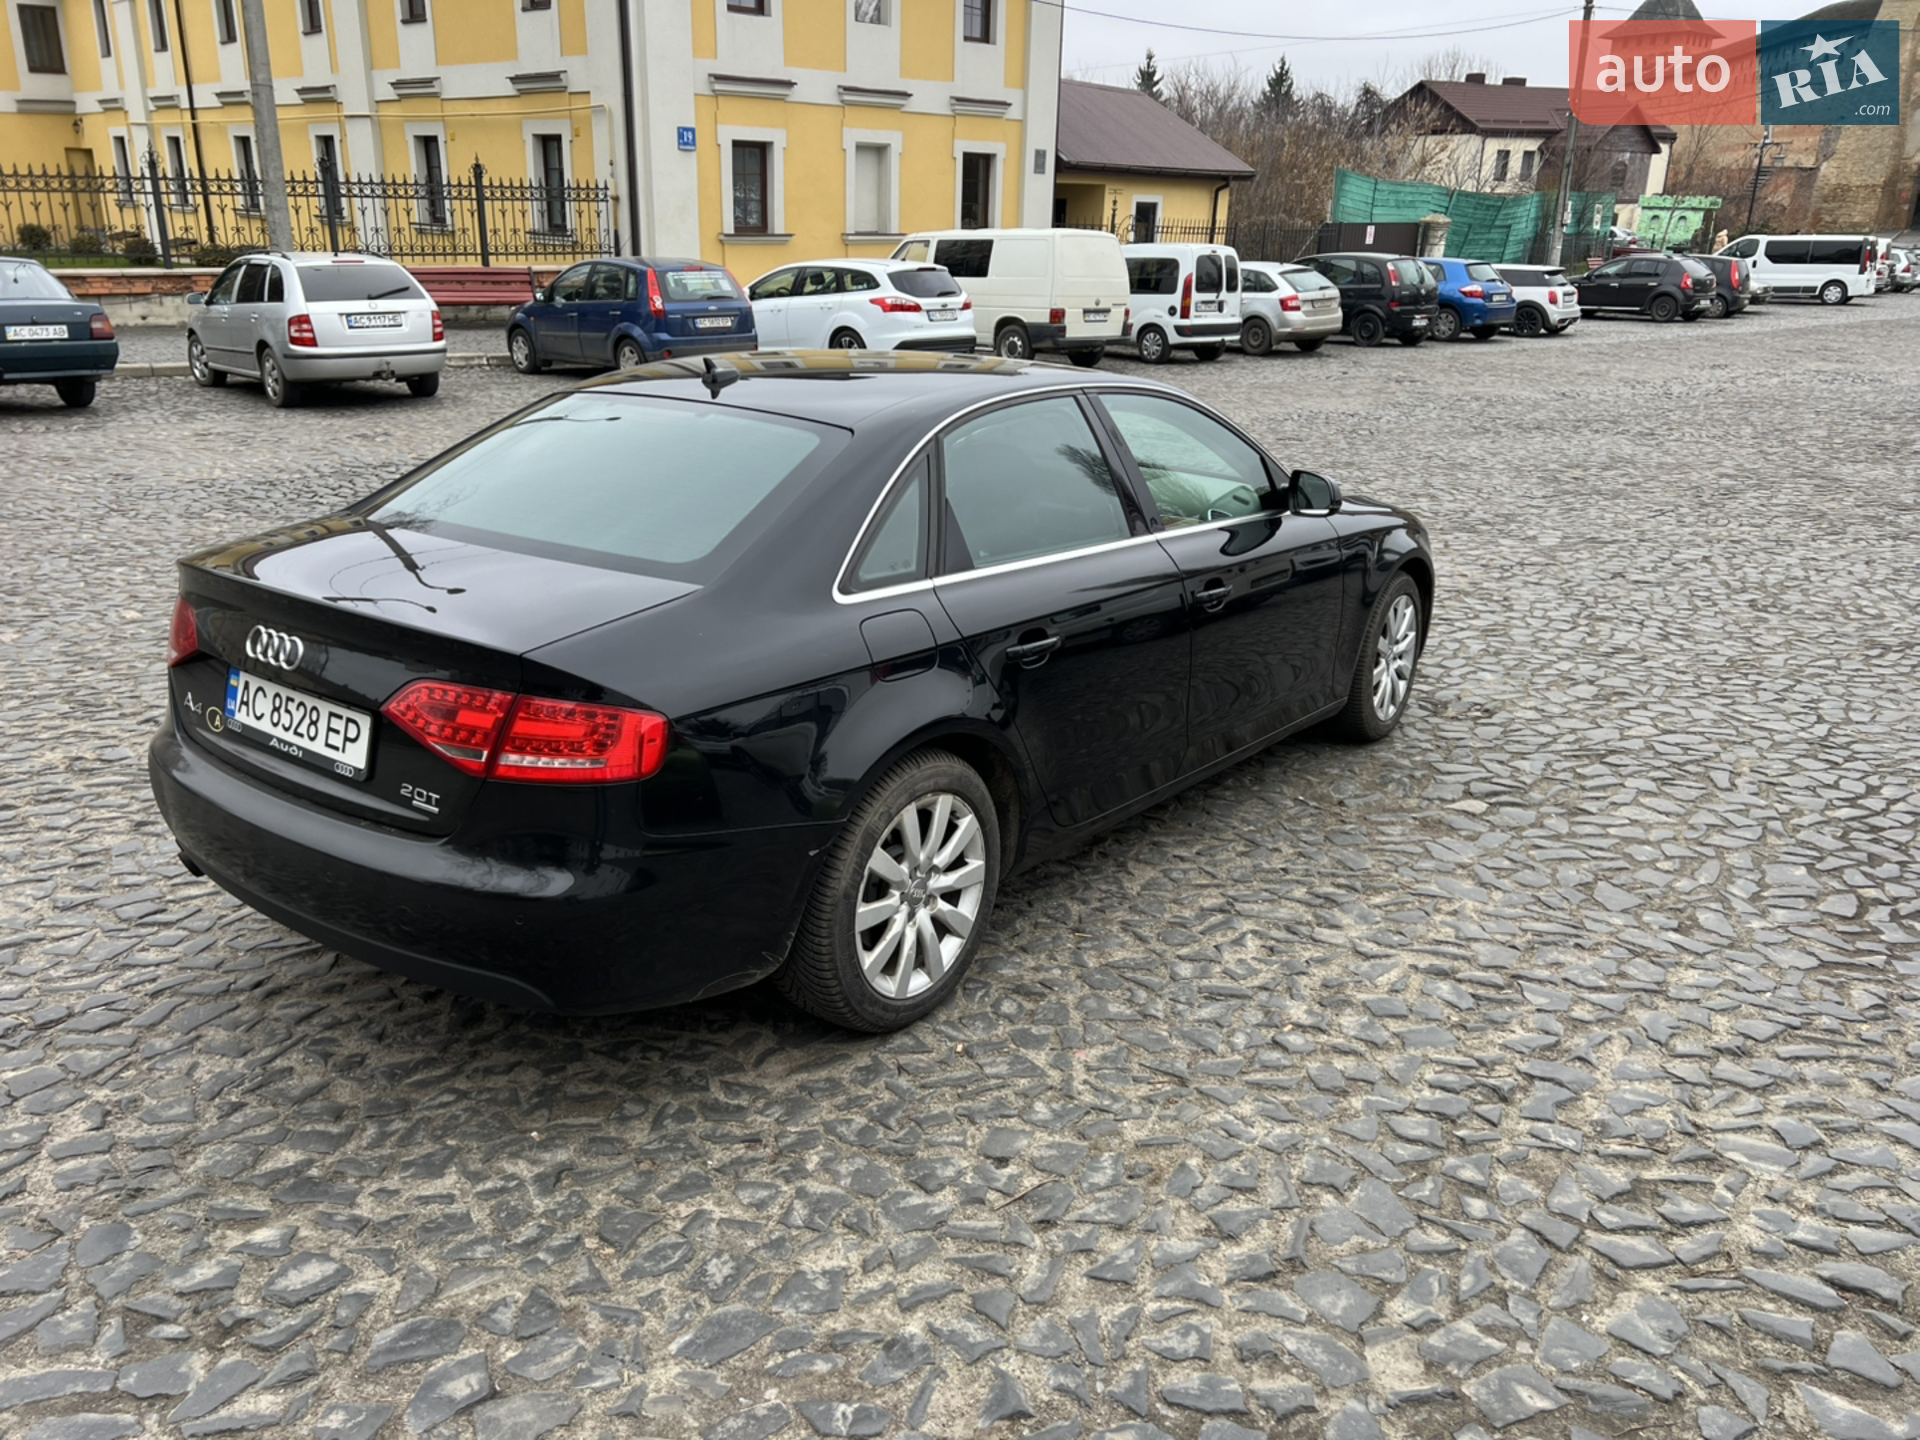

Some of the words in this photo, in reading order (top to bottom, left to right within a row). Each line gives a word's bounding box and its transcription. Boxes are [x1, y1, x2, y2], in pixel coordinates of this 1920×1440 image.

[13, 328, 26, 337] AC
[183, 692, 204, 715] A4
[237, 679, 268, 722] AC
[269, 691, 321, 742] 8528
[323, 711, 361, 755] EP
[268, 737, 304, 758] Audi
